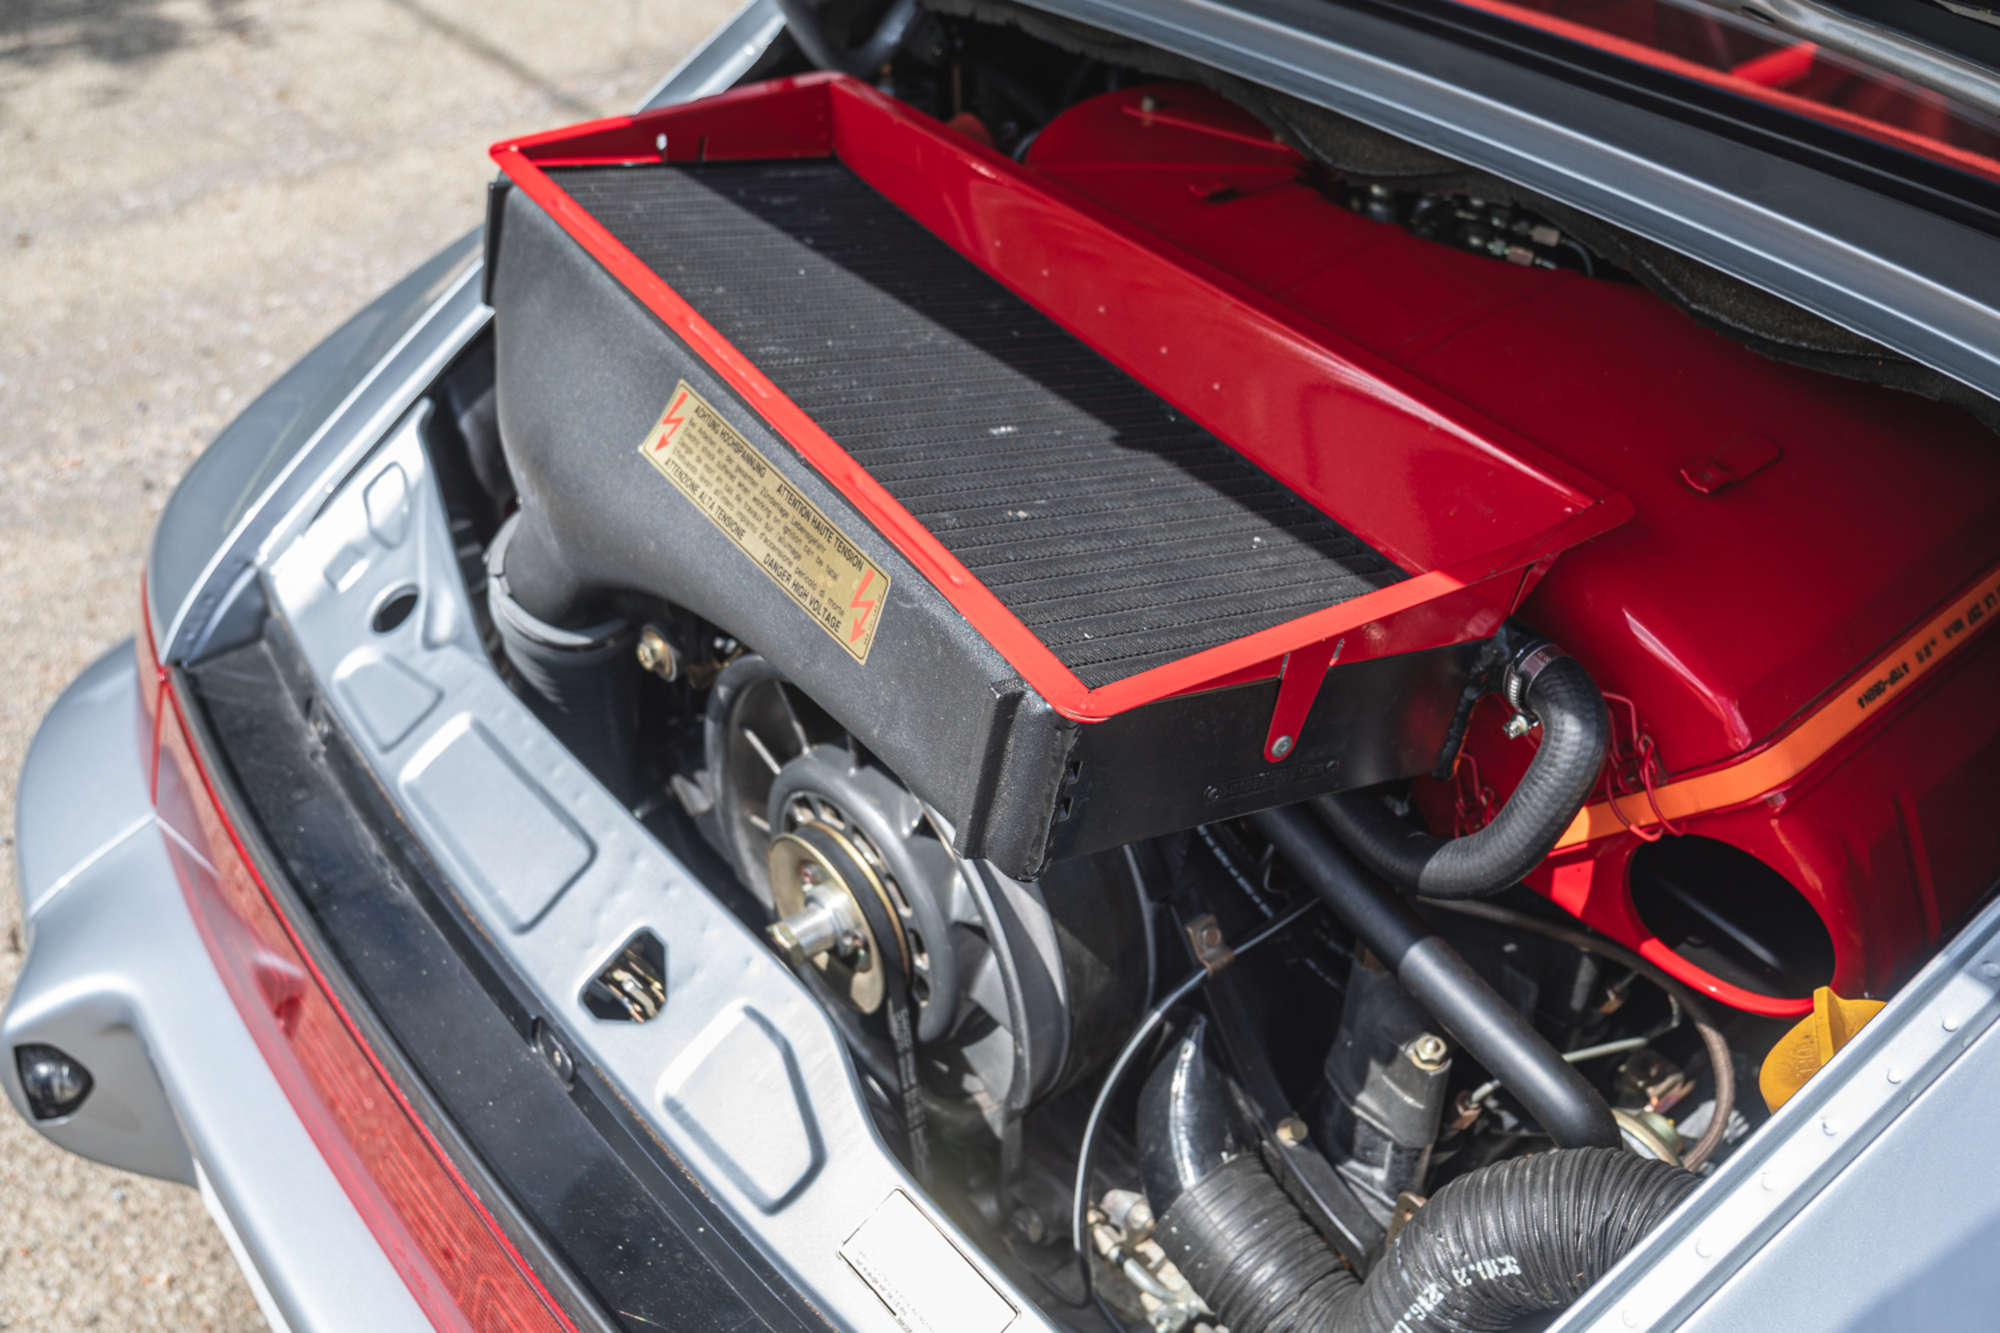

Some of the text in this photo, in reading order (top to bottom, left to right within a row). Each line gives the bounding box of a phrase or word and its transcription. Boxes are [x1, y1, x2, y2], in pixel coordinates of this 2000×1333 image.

[694, 405, 766, 478] ACHTUNG HOCHSPANNUNG
[665, 458, 746, 540] ATTENZIONE ALTA TENSIONE
[776, 484, 864, 571] ATTENTION HAUTE TENSION
[763, 553, 792, 583] DANGER
[791, 580, 810, 601] HIGH
[809, 596, 842, 633] VOLTAGE
